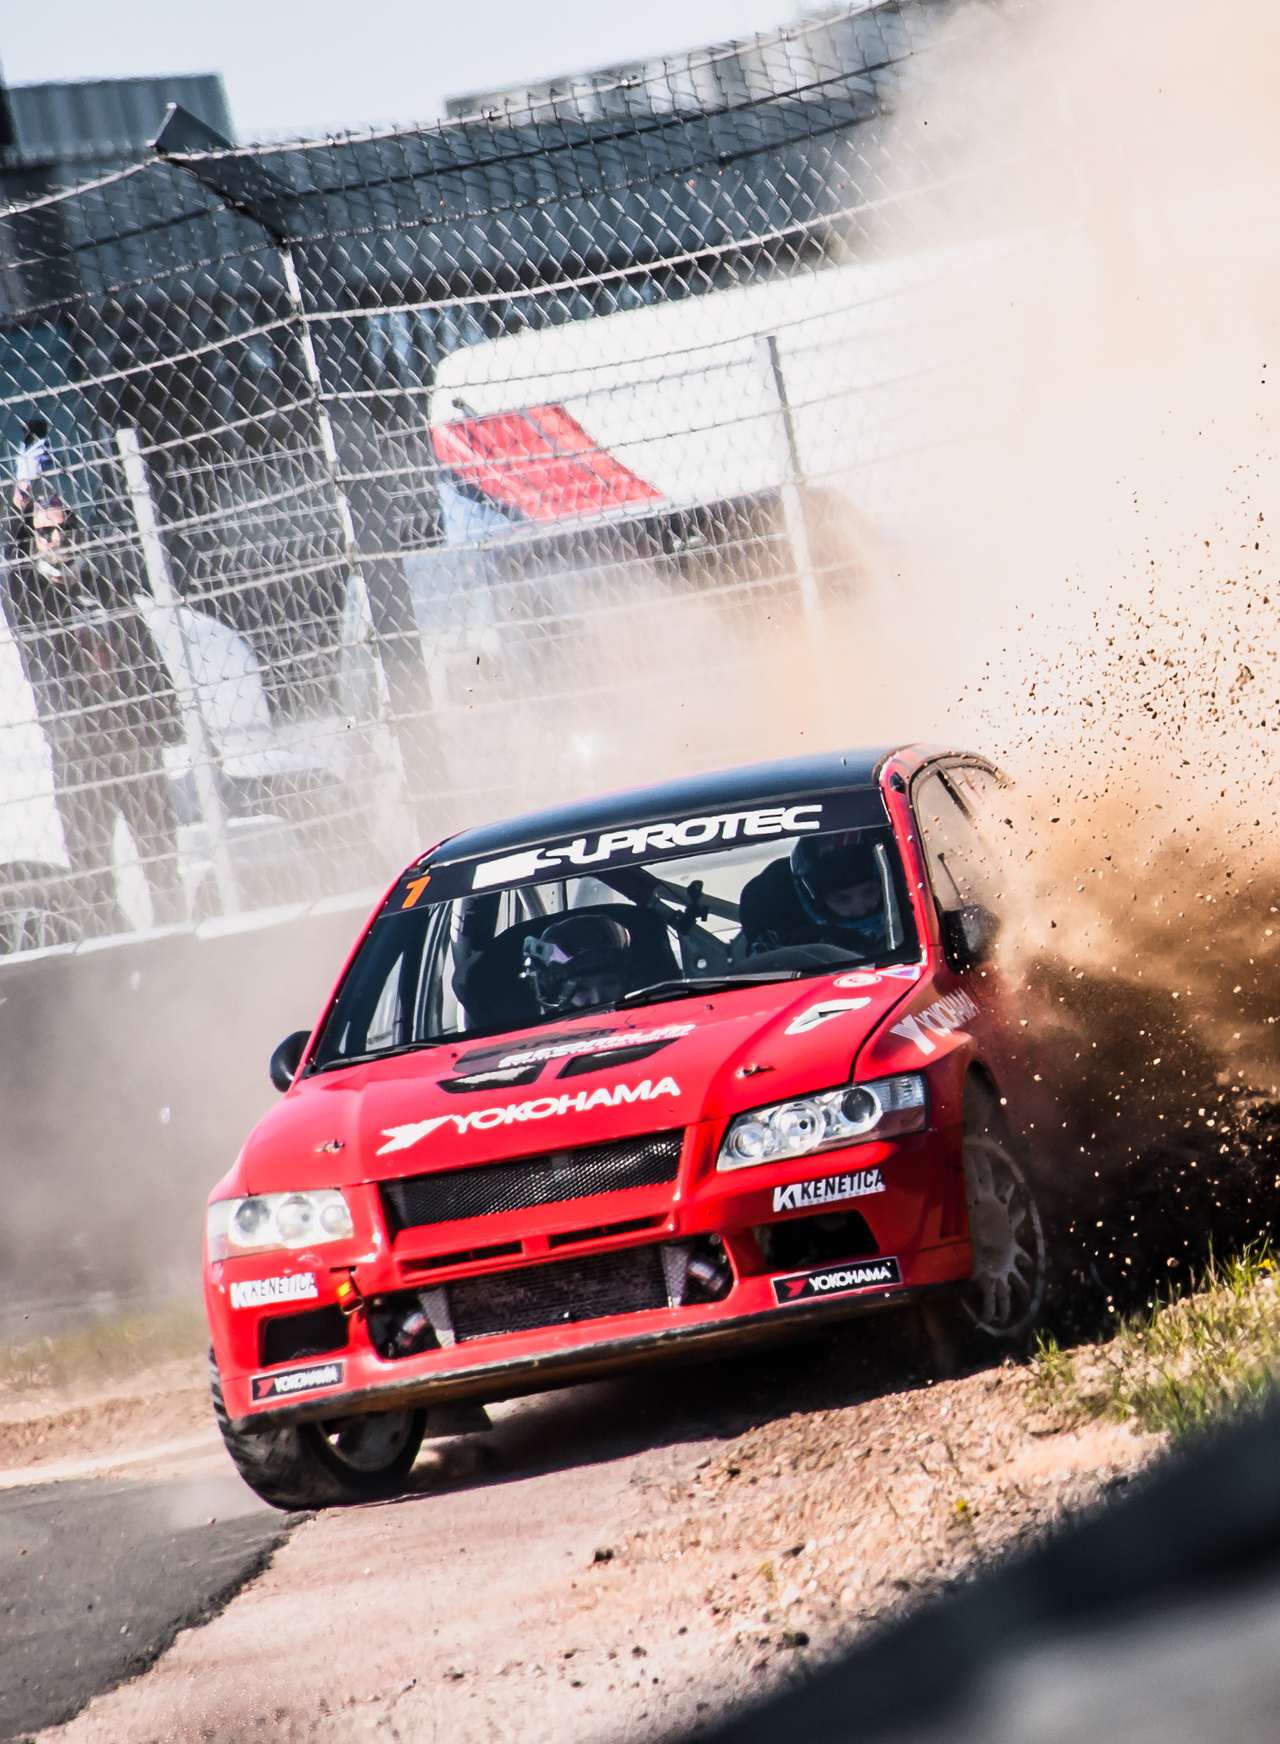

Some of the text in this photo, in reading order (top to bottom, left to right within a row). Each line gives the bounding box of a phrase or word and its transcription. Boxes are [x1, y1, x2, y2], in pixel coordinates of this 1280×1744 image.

[533, 804, 823, 867] SUPROTEC
[401, 875, 431, 909] 1
[451, 1076, 682, 1135] YOKOHAMA
[801, 1168, 885, 1200] KENETICA
[251, 1272, 318, 1297] KENETICA
[808, 1265, 892, 1292] YOKOHAMA
